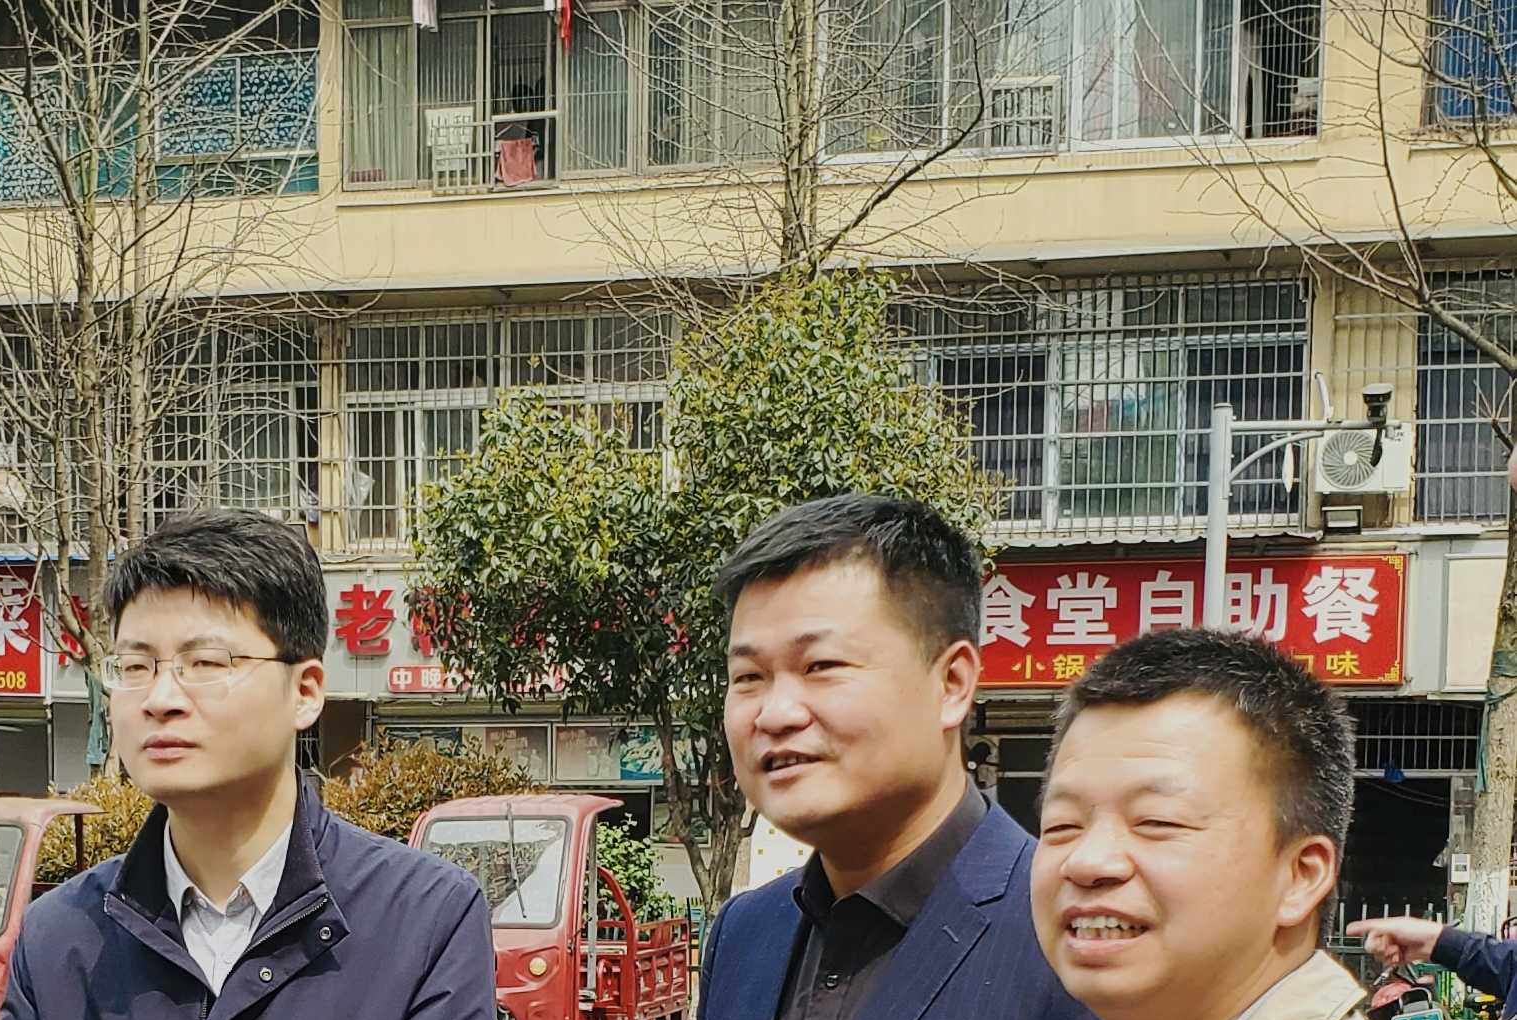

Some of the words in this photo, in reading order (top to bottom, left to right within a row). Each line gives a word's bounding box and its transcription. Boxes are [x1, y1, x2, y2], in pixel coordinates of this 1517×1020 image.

[978, 566, 1379, 647] 食堂自助餐
[1011, 654, 1101, 680] 小锅
